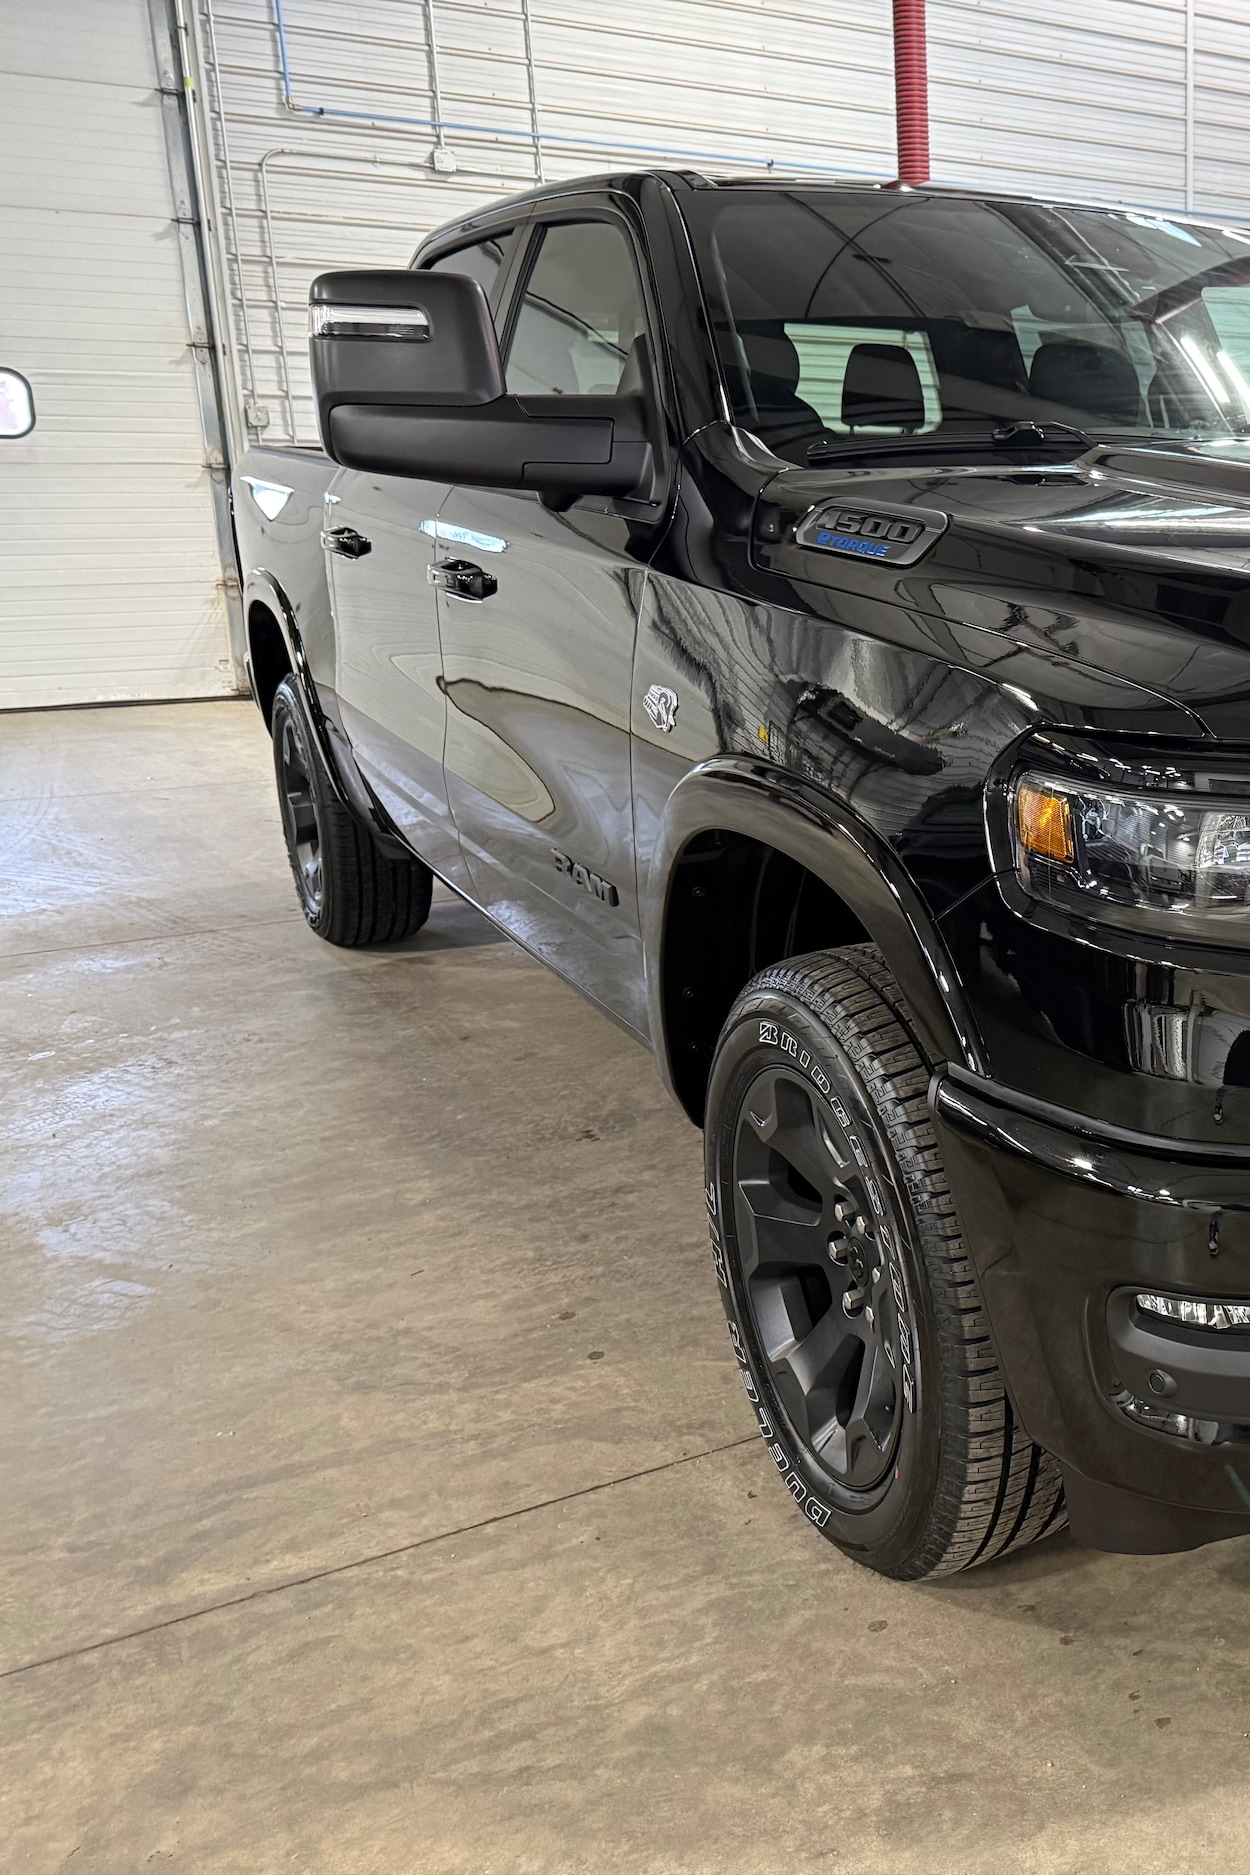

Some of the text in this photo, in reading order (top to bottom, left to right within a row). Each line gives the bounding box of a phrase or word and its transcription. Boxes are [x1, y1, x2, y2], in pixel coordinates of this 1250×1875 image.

[817, 507, 922, 543] 1500
[550, 848, 619, 907] RAM
[758, 1020, 917, 1414] BRIDGESTONE
[726, 1319, 833, 1528] DUELER
